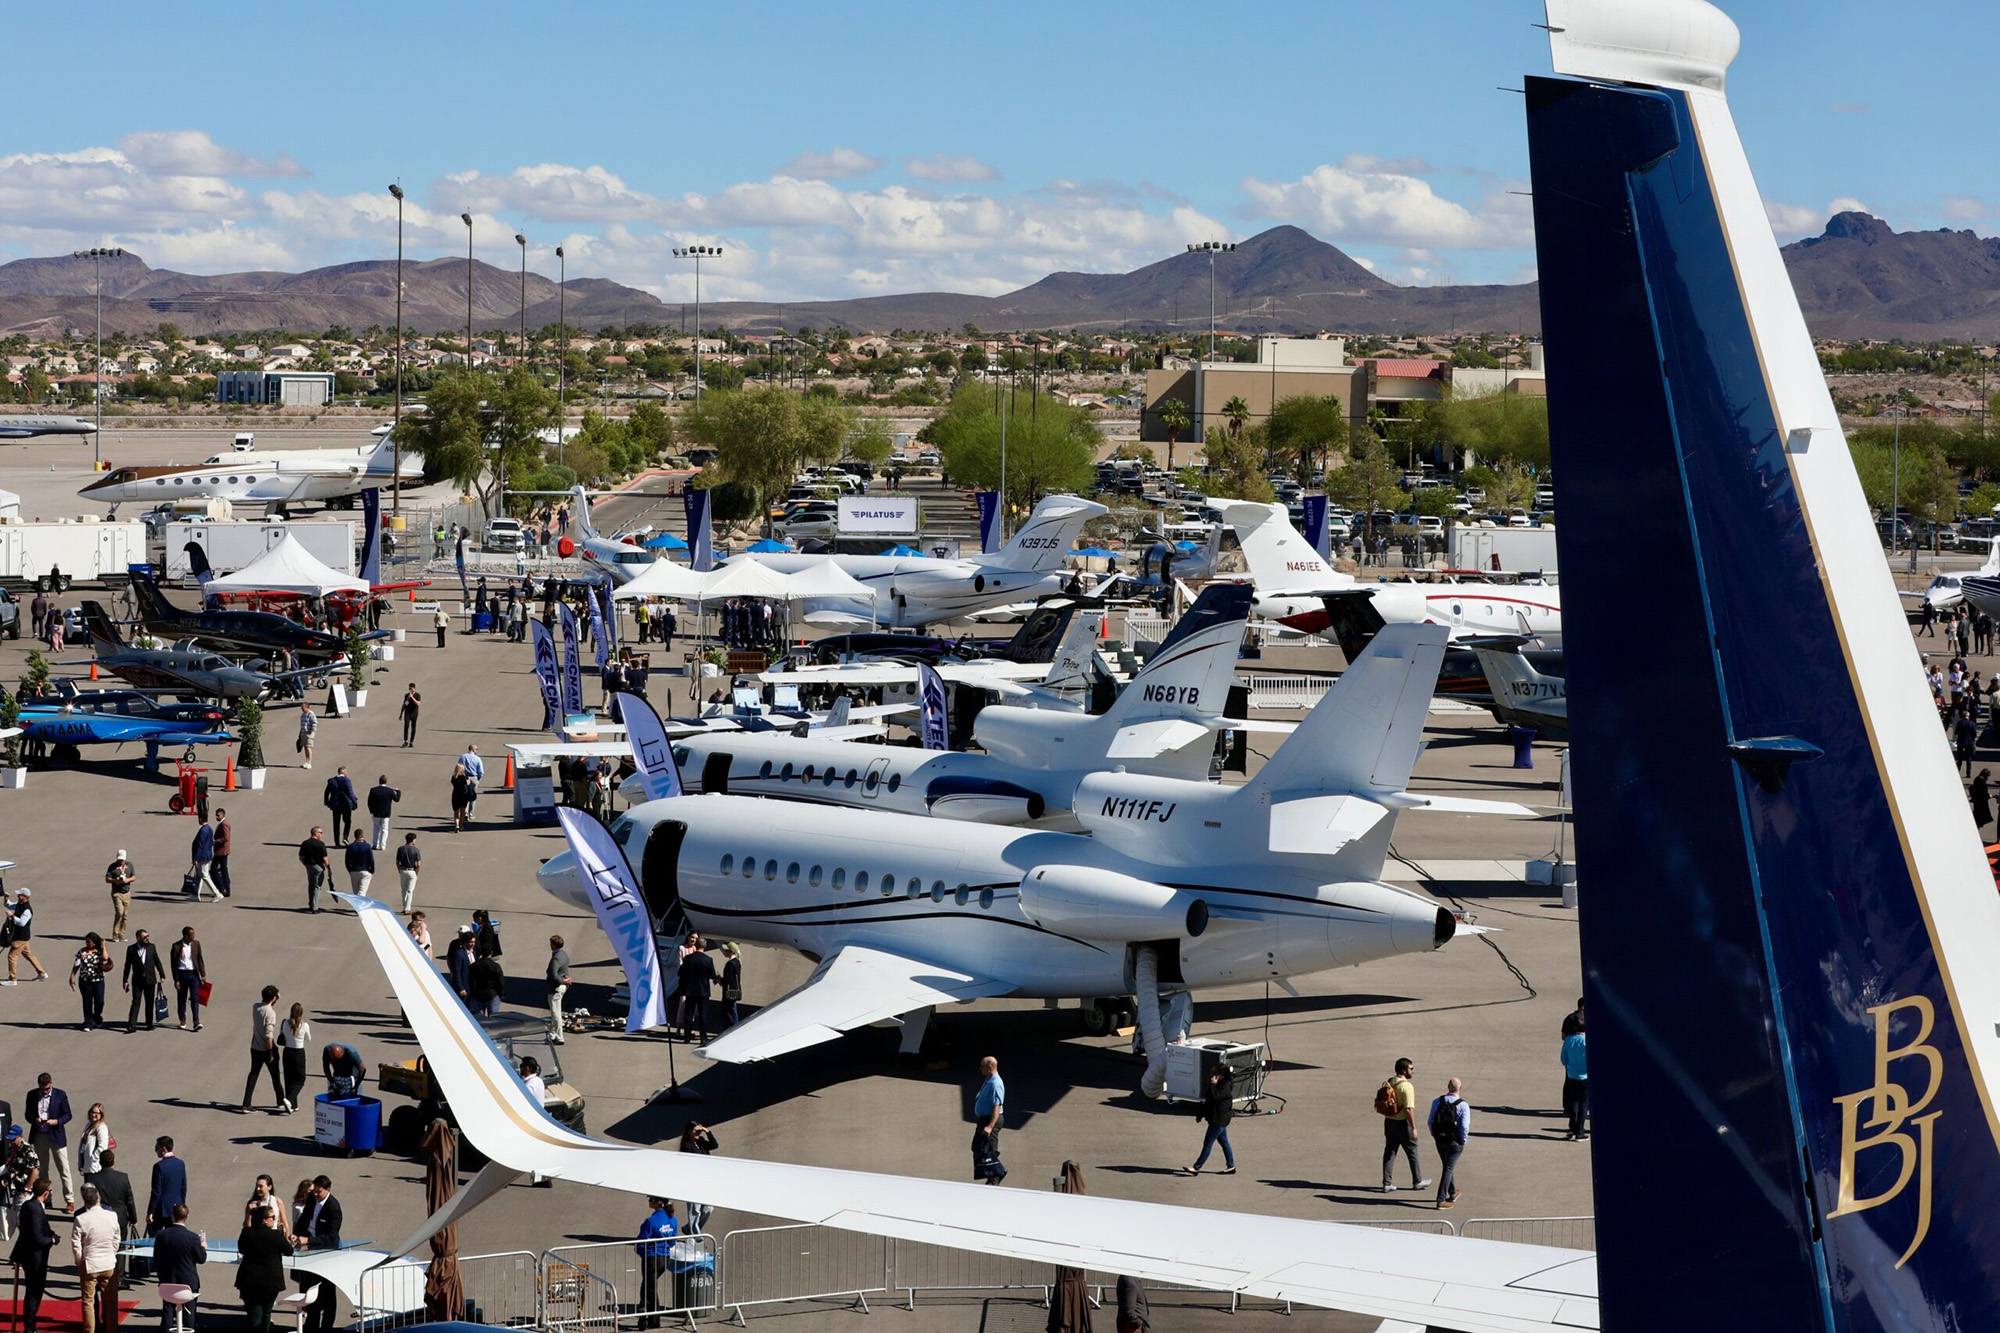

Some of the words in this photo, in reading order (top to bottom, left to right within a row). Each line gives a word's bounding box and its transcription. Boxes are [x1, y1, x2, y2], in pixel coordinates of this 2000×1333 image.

[1018, 538, 1060, 549] N397JS
[1286, 561, 1321, 572] N461EE
[568, 644, 580, 711] TECNAM
[1143, 684, 1200, 704] N68YB
[1511, 682, 1567, 697] N377VJ
[38, 722, 94, 738] N744MA
[1101, 796, 1177, 822] N111FJ
